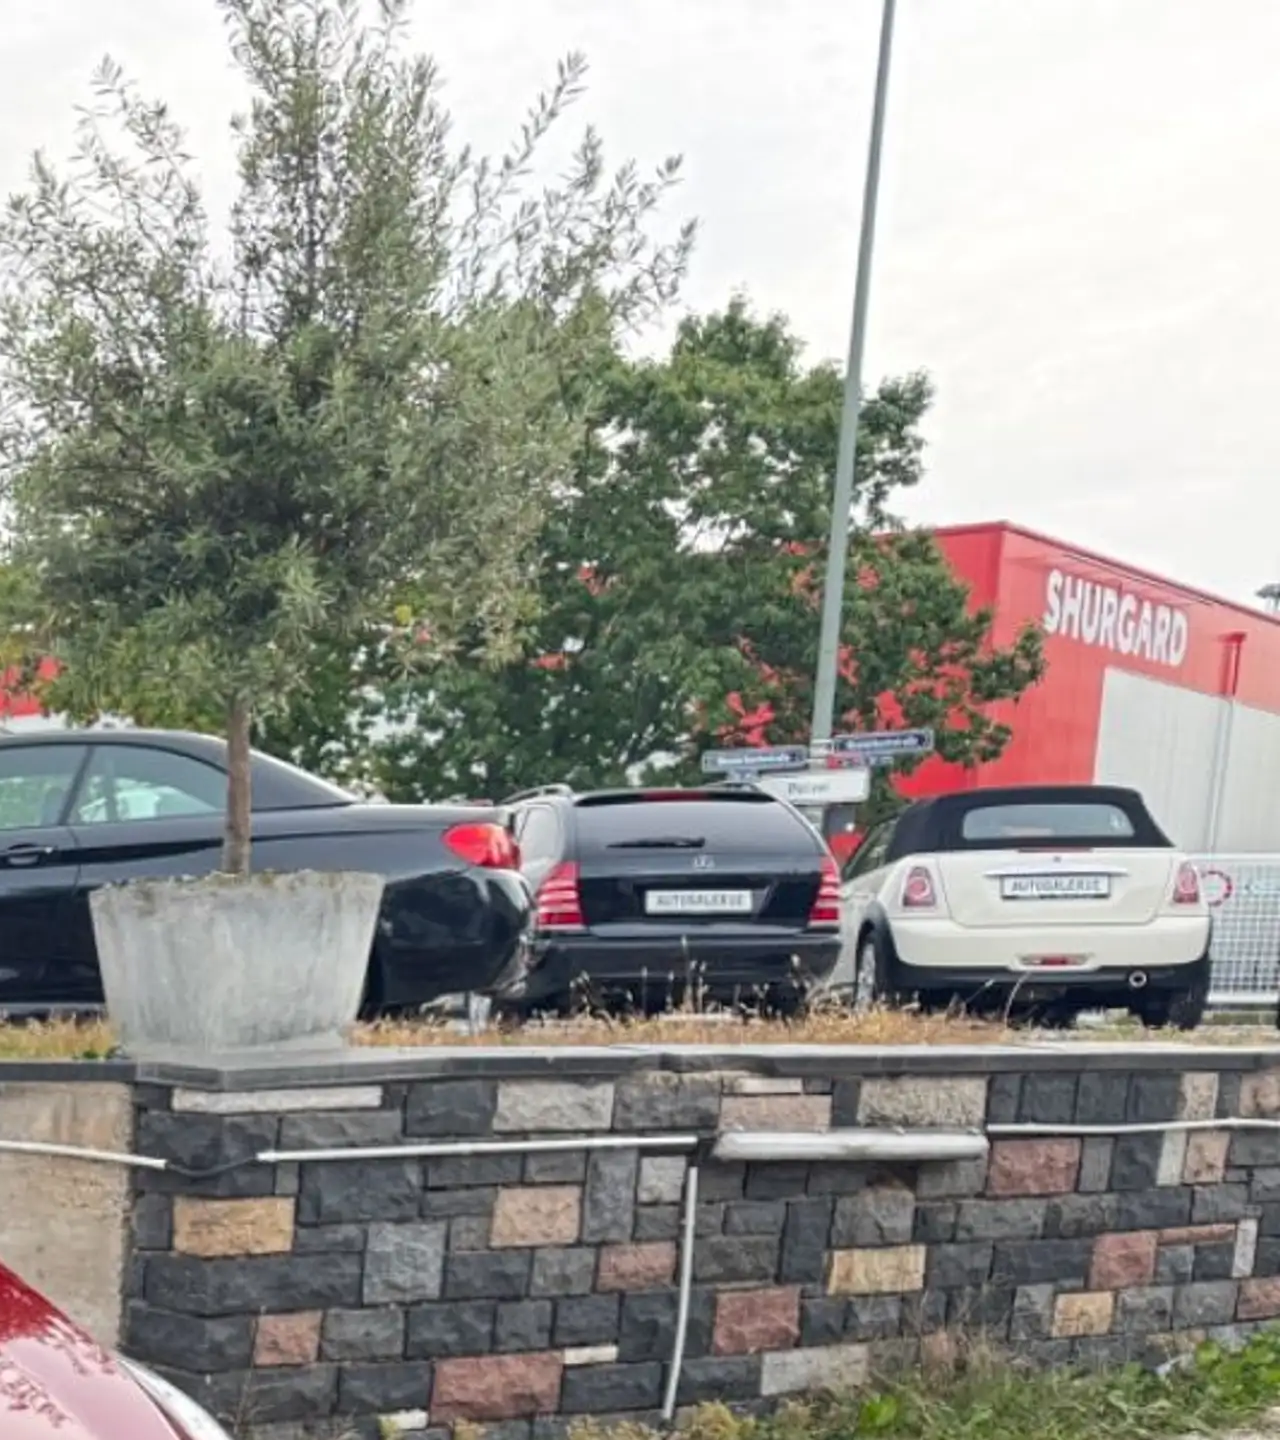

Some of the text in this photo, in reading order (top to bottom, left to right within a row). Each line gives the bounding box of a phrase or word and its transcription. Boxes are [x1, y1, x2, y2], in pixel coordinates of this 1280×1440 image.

[1042, 569, 1189, 666] SHURGARD
[1011, 875, 1102, 894] AUTOGALERIE
[655, 890, 745, 909] AUTOGALERIE
